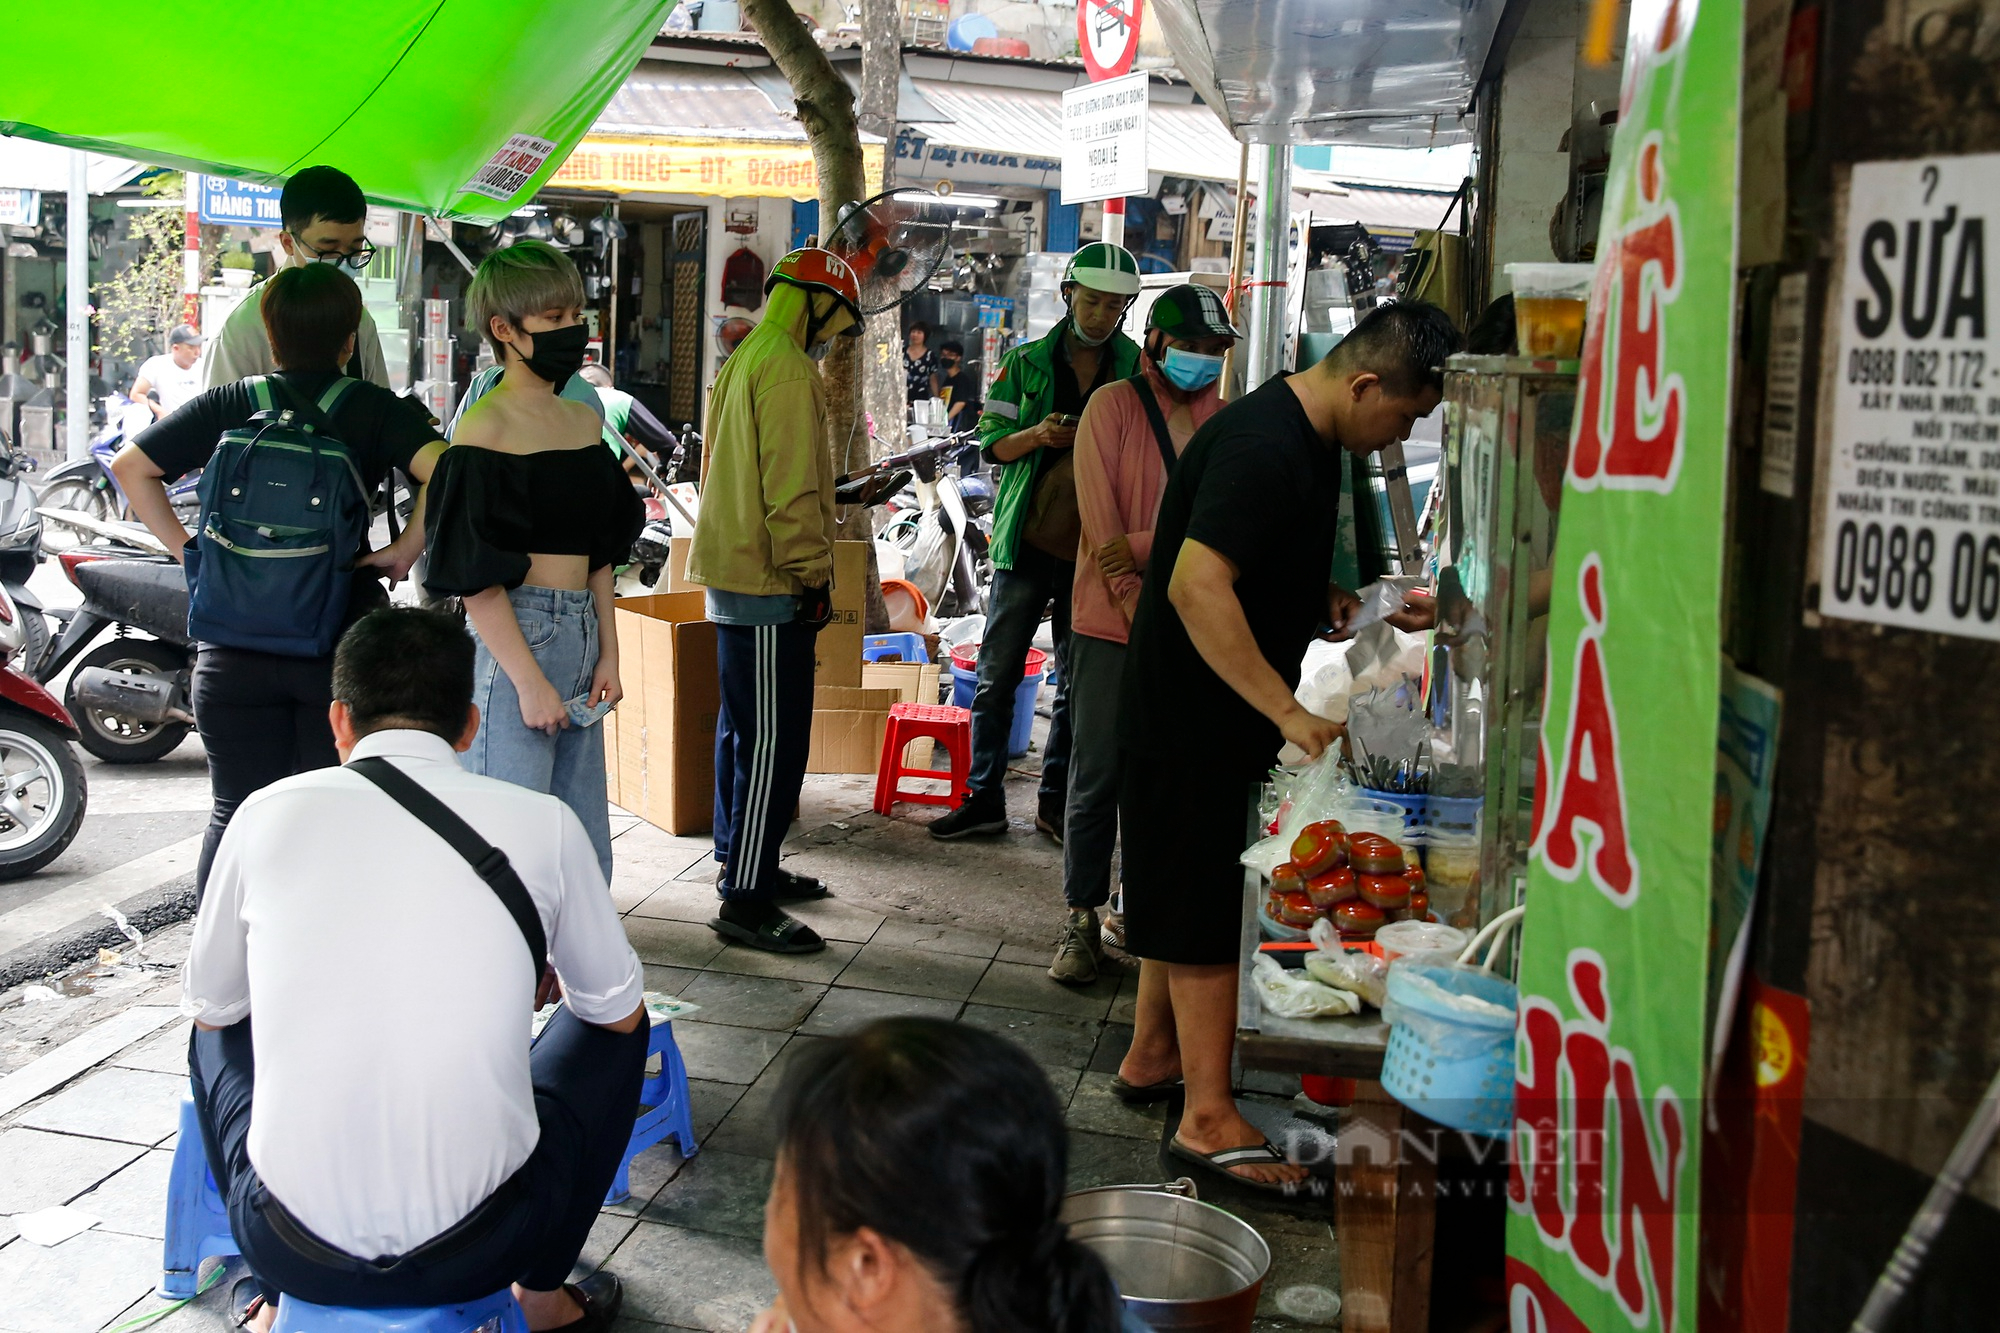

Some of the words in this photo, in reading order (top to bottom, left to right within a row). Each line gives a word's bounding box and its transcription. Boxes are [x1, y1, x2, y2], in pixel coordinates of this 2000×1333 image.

[211, 191, 252, 217] HÀNG
[1855, 165, 1985, 339] SỬA
[1849, 349, 1895, 385] 0988
[1903, 350, 1939, 387] 062
[1948, 351, 1985, 389] 172
[1860, 389, 1893, 410] XÂY
[1898, 389, 1933, 412] NHÀ
[1853, 438, 1911, 464] CHỐNG
[1836, 490, 1883, 518] NHẬN
[1890, 496, 1915, 516] THI
[1921, 497, 1970, 522] CÔNG
[1834, 519, 1935, 614] 0988
